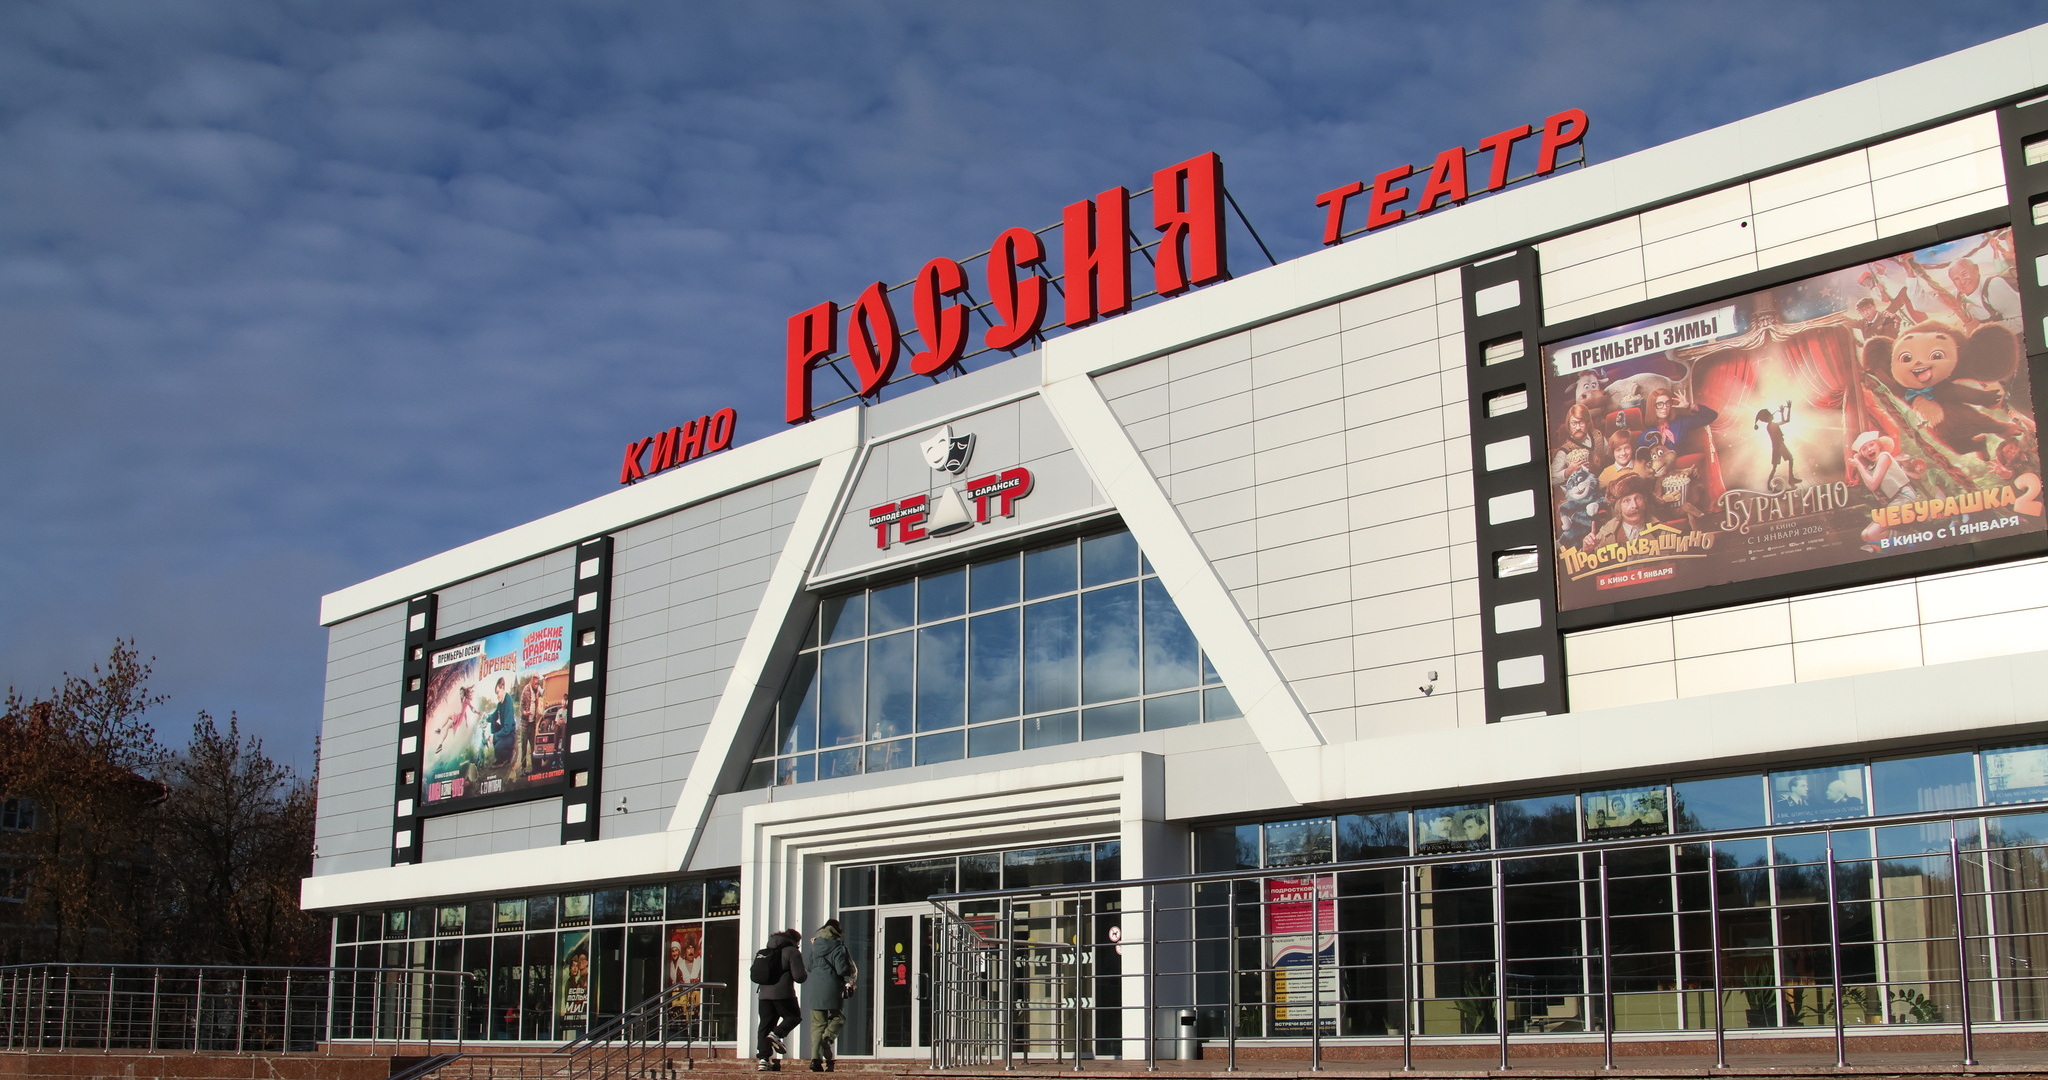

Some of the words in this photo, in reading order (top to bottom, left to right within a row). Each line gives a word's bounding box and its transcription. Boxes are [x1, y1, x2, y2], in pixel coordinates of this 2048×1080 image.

[1315, 108, 1589, 246] ТЕАТР
[786, 151, 1224, 425] РОССИЯ
[1571, 331, 1660, 369] ПРЕМЬЕРЫ
[1663, 316, 1718, 345] ЗИМЫ
[620, 407, 737, 485] КИНО
[968, 491, 973, 499] В
[975, 478, 1020, 496] САРАНСКЕ
[1870, 485, 2017, 528] ЧЕБУРАШКА
[2013, 472, 2043, 517] 2
[1717, 480, 1849, 535] БУРАТИНО
[1747, 536, 1755, 545] С
[1757, 535, 1761, 543] 1
[1763, 528, 1800, 542] ЯНВАРЯ
[1802, 525, 1823, 536] 2026
[1775, 521, 1797, 531] КИНО
[1880, 538, 1890, 549] В
[1893, 530, 1934, 547] КИНО
[1937, 528, 1947, 539] С
[1949, 526, 1956, 537] 1
[1959, 515, 2020, 535] ЯНВАРЯ
[1559, 530, 1715, 575] ПРОСТОКВАШИНО
[1600, 578, 1606, 586] В
[1607, 574, 1629, 584] КИНО
[1630, 573, 1635, 581] С
[1637, 570, 1643, 579] 1
[1643, 567, 1673, 579] ЯНВАРЯ
[437, 648, 464, 664] ПРЕМЬЕРЫ
[464, 643, 481, 657] ОСЕНИ
[522, 638, 562, 661] ПРАВИЛА
[523, 626, 563, 647] МУЖСКИЕ
